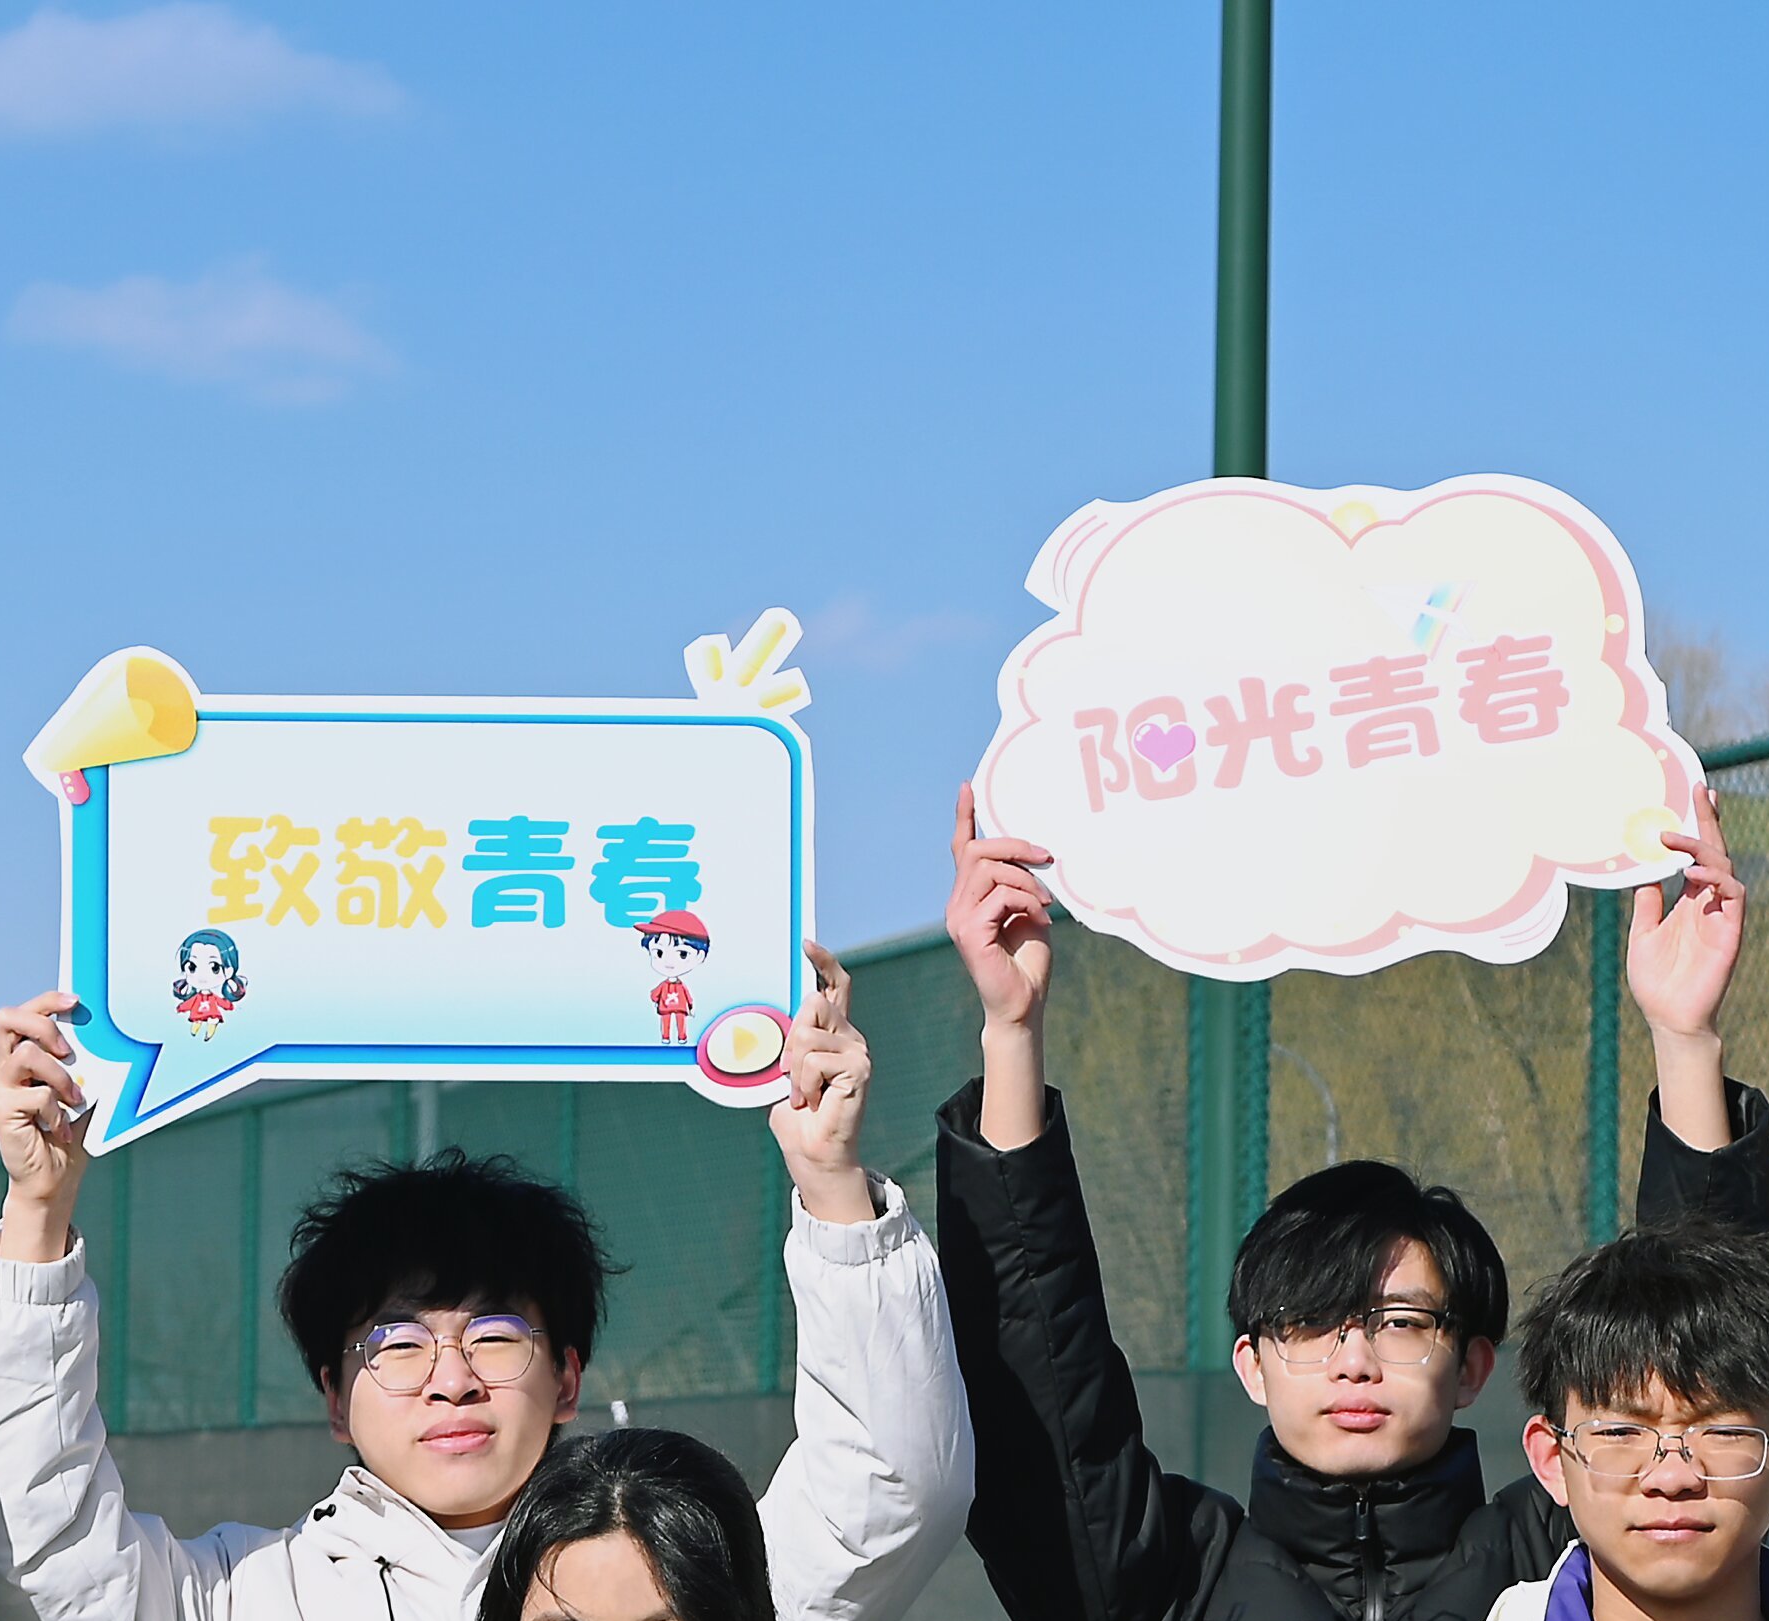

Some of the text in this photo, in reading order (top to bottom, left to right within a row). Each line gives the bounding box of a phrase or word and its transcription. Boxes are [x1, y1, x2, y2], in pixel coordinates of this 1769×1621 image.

[1073, 635, 1571, 813] 阳光青春
[207, 813, 702, 930] 致敬青春
